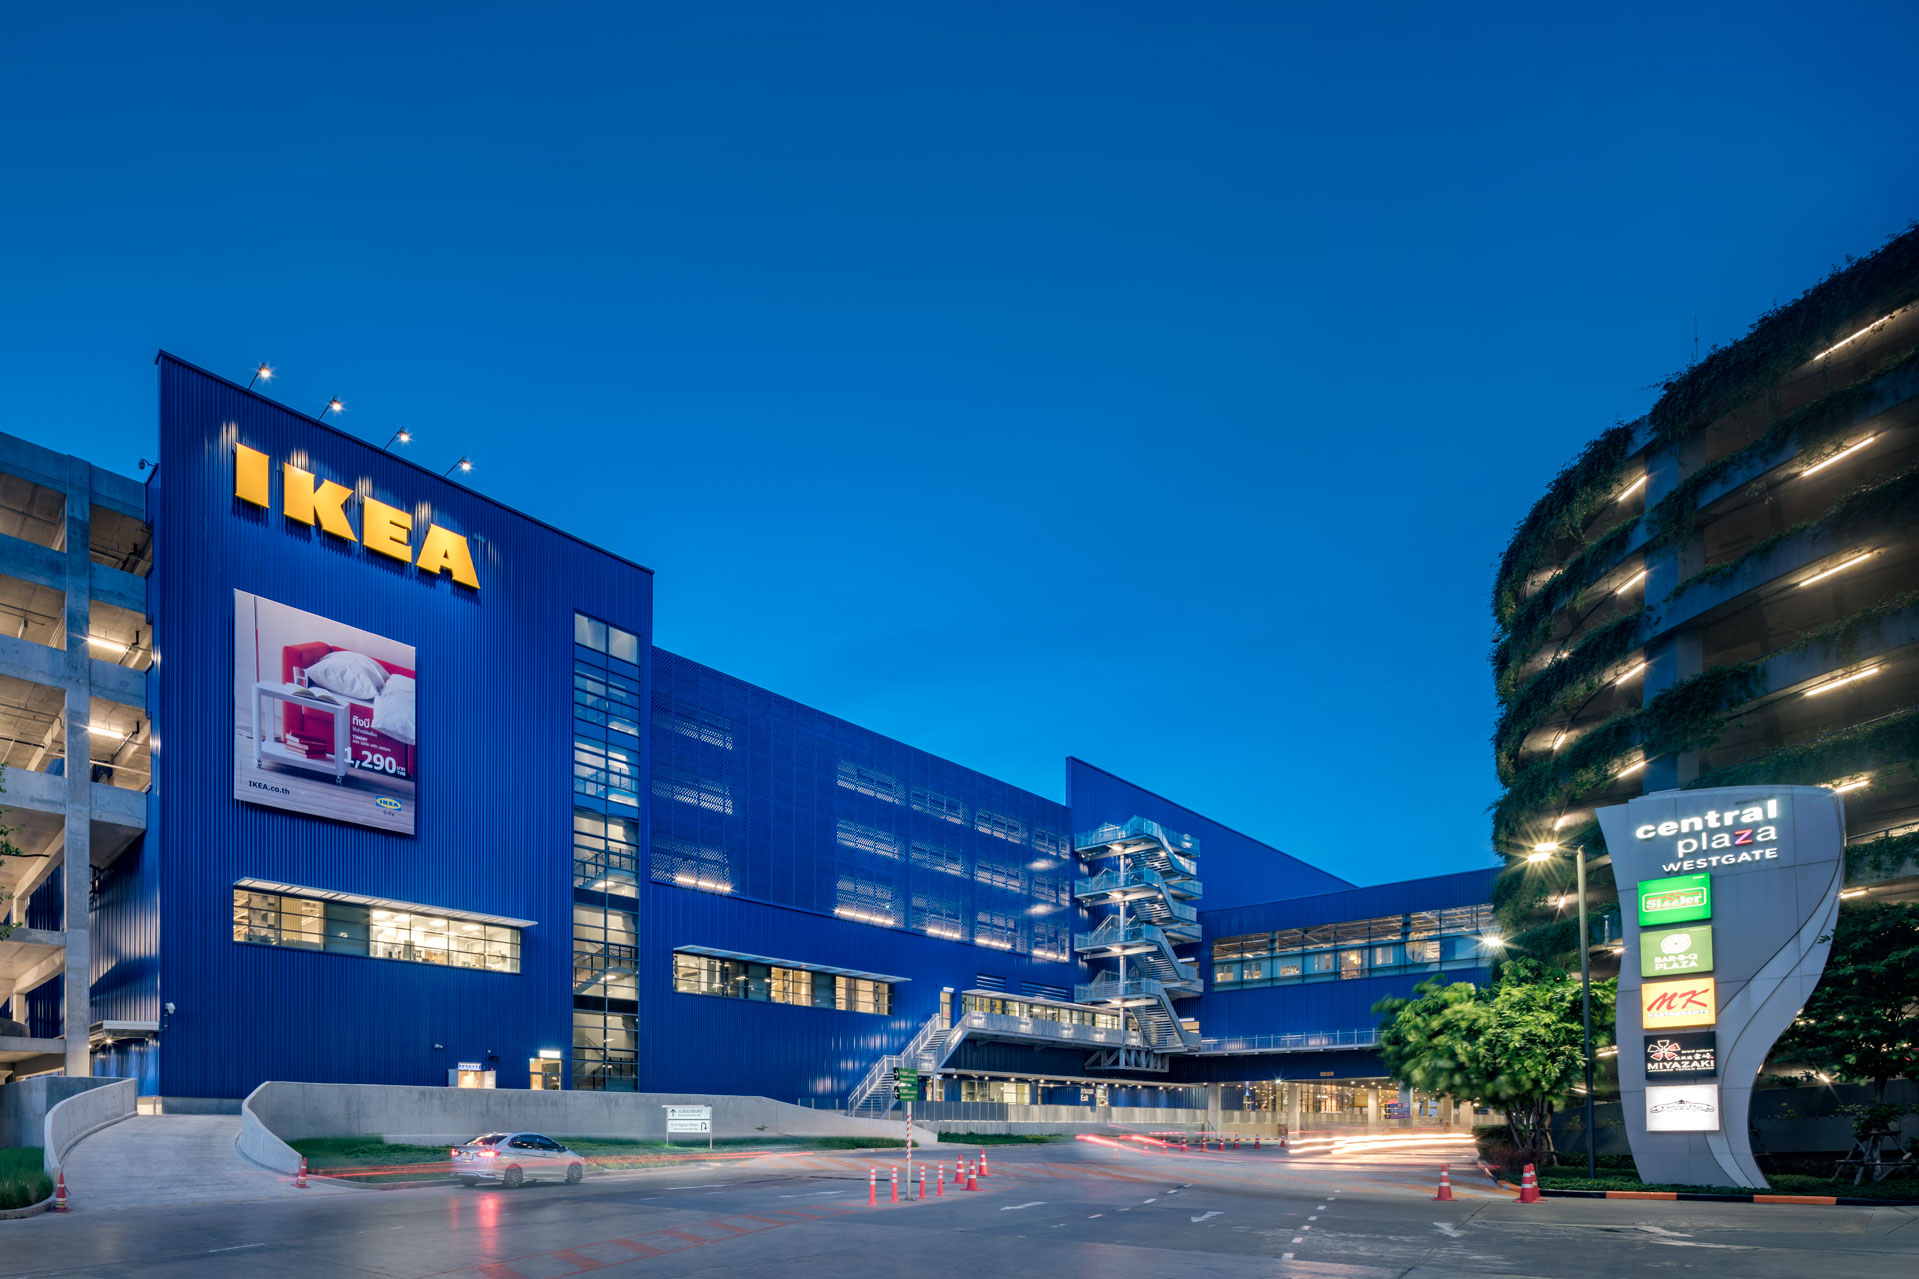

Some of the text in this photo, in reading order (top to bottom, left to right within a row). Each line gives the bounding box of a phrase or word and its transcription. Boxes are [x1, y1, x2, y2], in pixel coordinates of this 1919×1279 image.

[235, 442, 480, 589] IKEA
[344, 746, 397, 774] 1,290
[248, 780, 290, 795] IKEA.co.th
[379, 799, 399, 808] IKEA
[1635, 799, 1777, 839] central
[1677, 825, 1777, 858] plaza
[1662, 848, 1778, 872] WESTGATE
[1646, 894, 1703, 909] Sizzler
[1654, 953, 1698, 963] BAR-B-Q
[1655, 960, 1698, 971] PLAZA
[1646, 988, 1710, 1012] MK
[1647, 1060, 1715, 1069] MIYAZAKI
